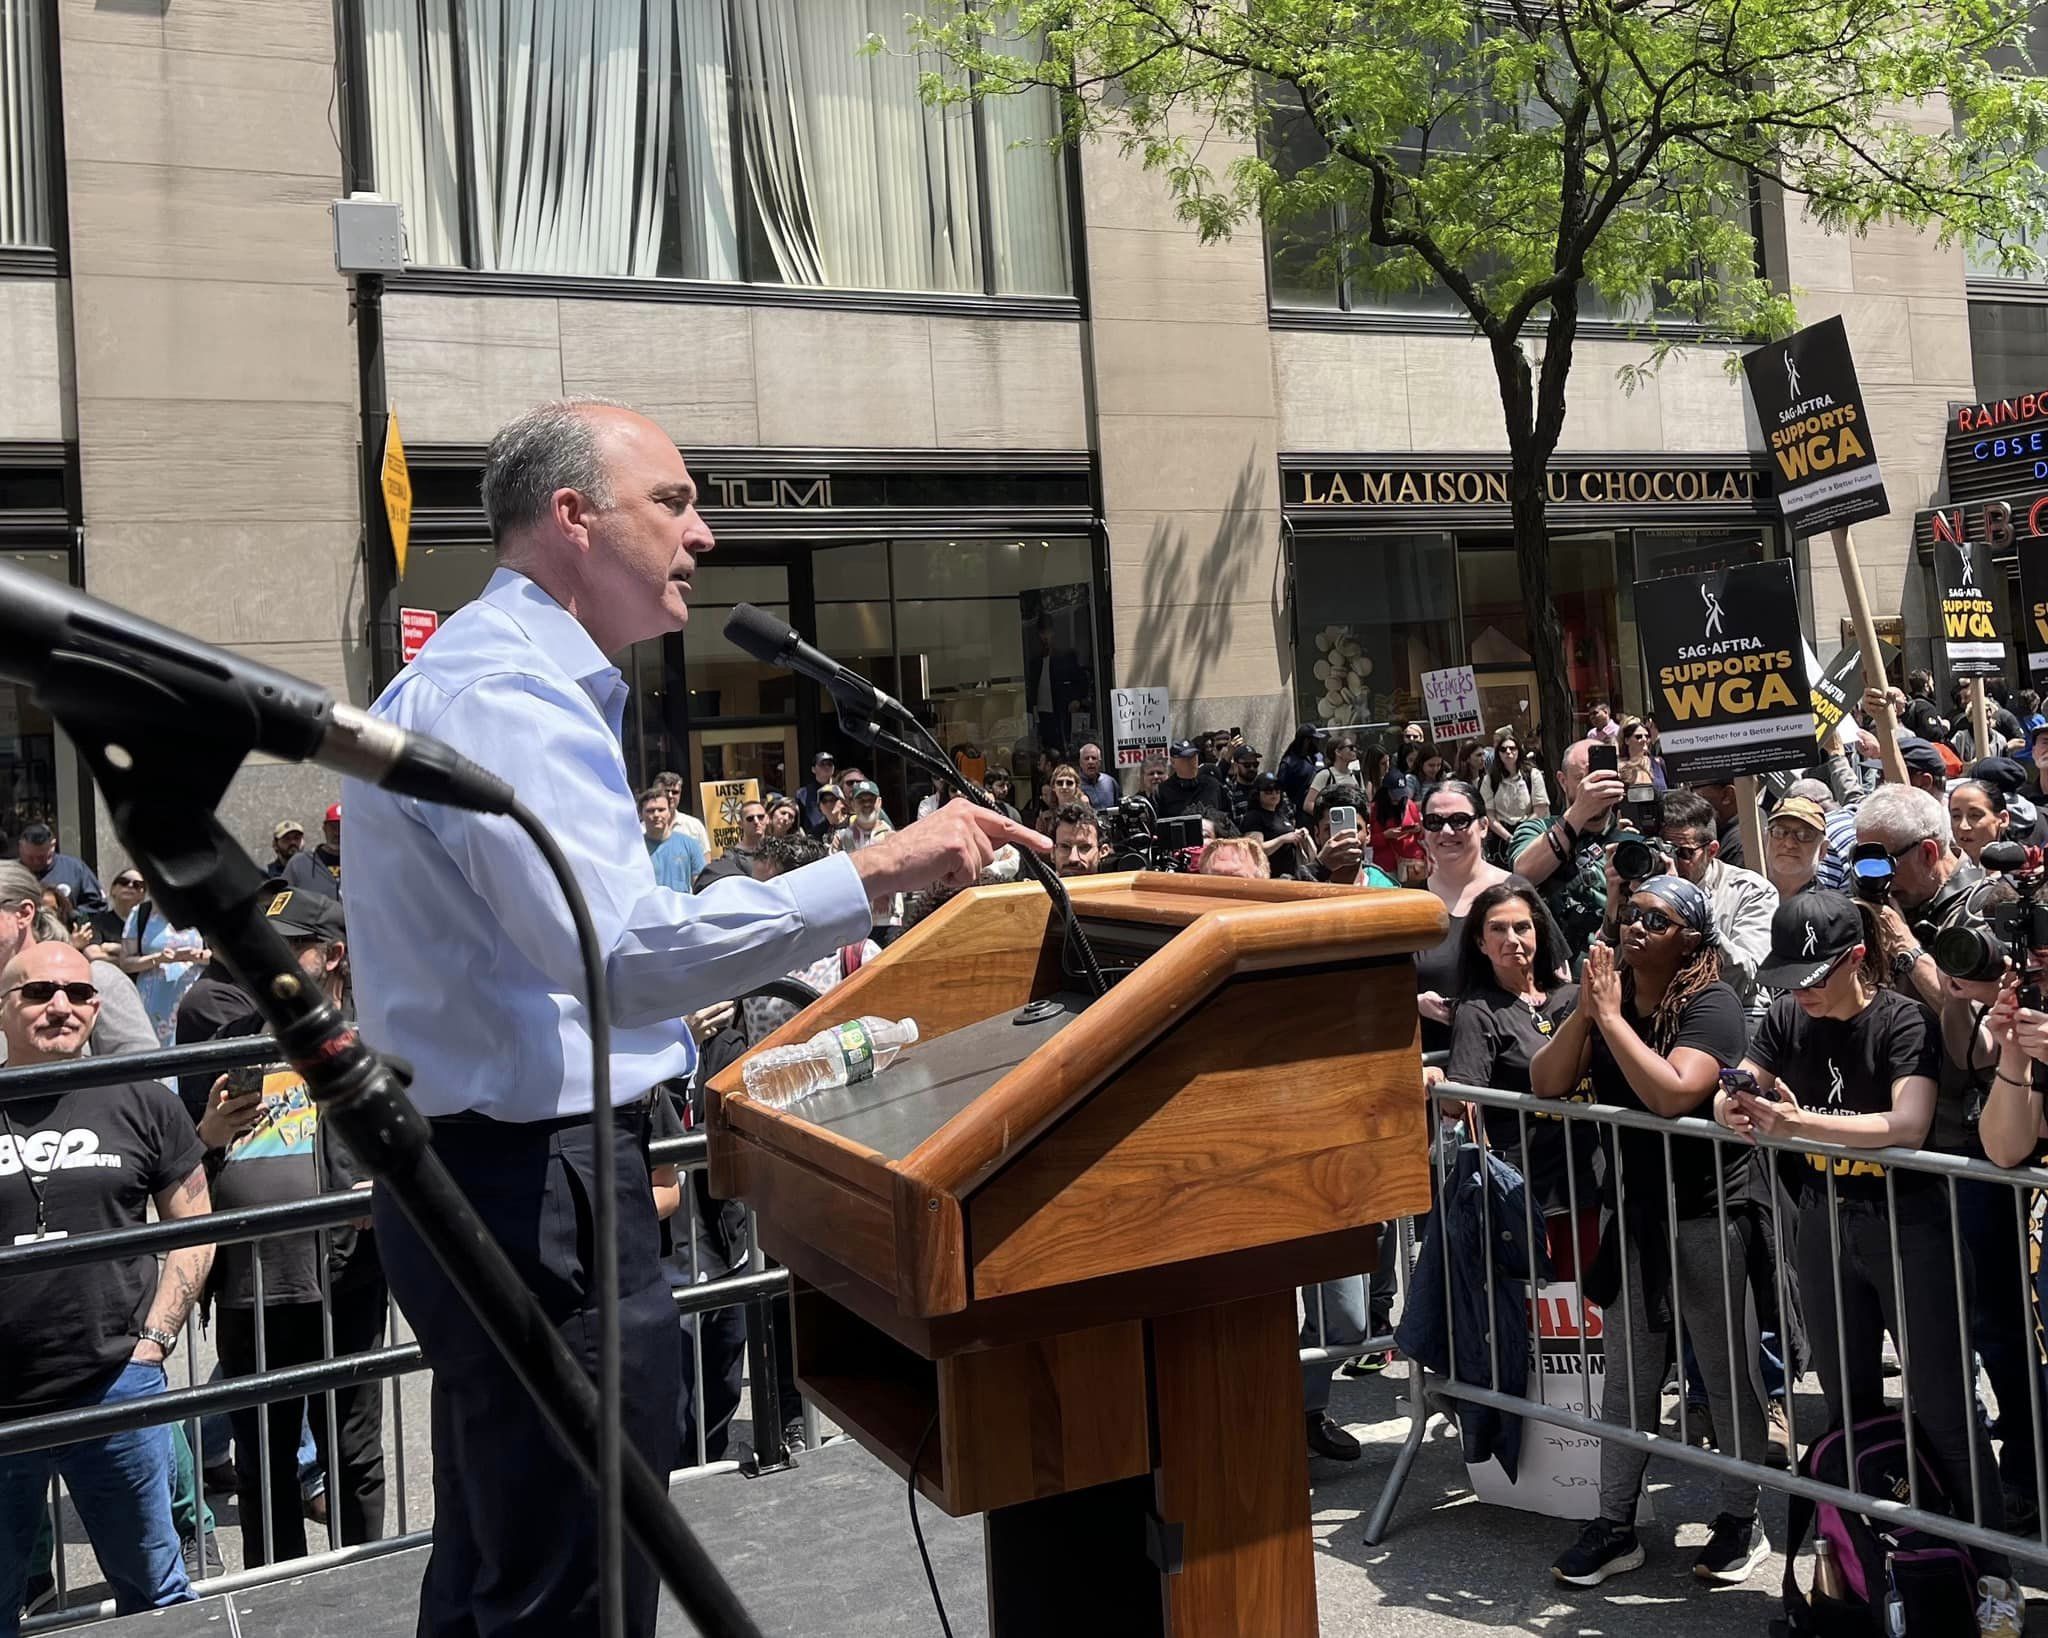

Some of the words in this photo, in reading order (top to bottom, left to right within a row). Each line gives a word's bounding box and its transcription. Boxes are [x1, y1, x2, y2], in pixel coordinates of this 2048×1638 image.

[1771, 404, 1857, 448] SUPPORTS
[1776, 427, 1866, 481] WGA
[708, 473, 832, 507] TUMI
[1302, 472, 1353, 504] LA
[1361, 472, 1512, 504] MAISON
[1579, 471, 1760, 502] CHOCOLAT
[1833, 479, 1854, 490] Better
[1659, 650, 1792, 685] SUPPORTS
[1117, 693, 1134, 707] Do
[1138, 692, 1160, 706] The
[1663, 672, 1798, 720] WGA
[1432, 712, 1458, 722] WRITERS
[1459, 709, 1477, 718] GUILD
[1118, 737, 1146, 745] WRITERS
[1147, 735, 1167, 743] GUILD
[1434, 719, 1481, 739] STRIKE!
[1671, 736, 1694, 746] Acting
[1695, 732, 1729, 744] Together
[1729, 730, 1741, 739] for
[1749, 726, 1774, 736] Better
[1776, 723, 1803, 733] Future
[715, 783, 746, 797] IATSE
